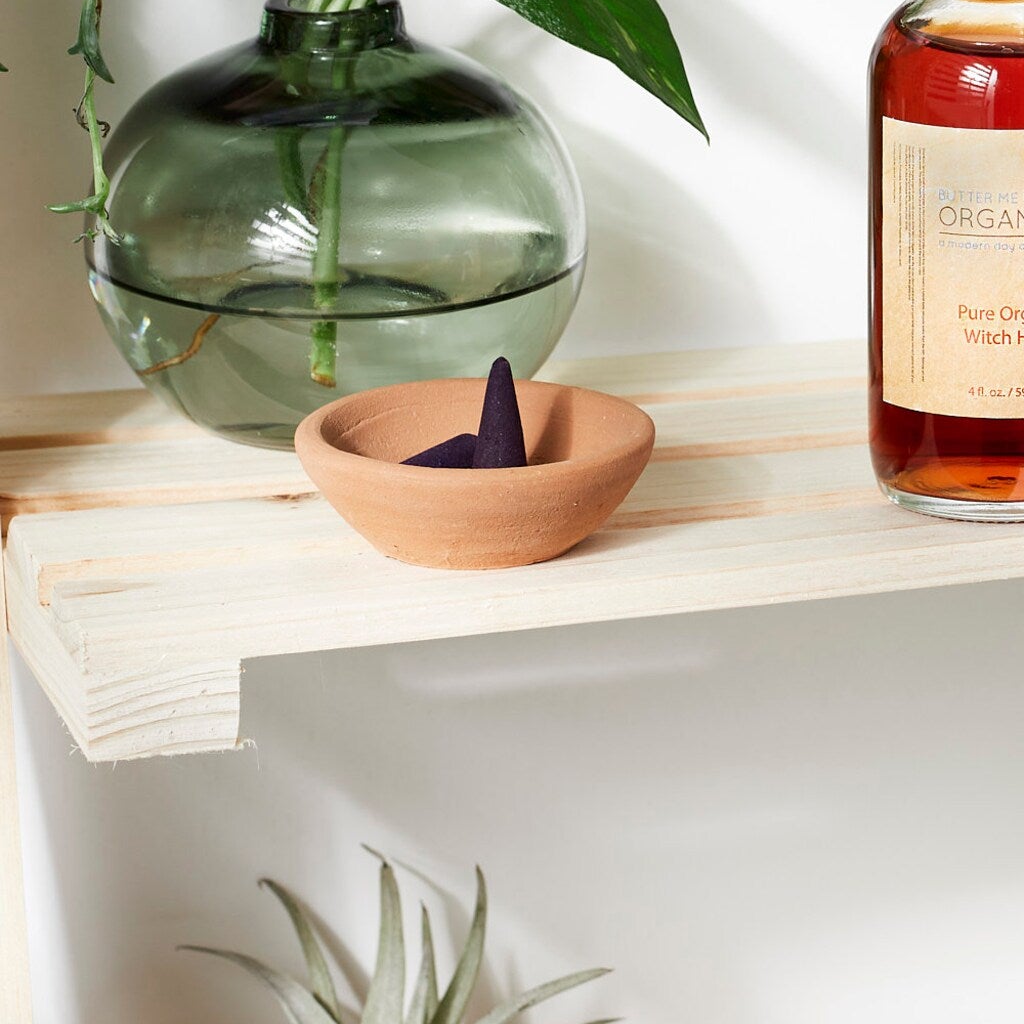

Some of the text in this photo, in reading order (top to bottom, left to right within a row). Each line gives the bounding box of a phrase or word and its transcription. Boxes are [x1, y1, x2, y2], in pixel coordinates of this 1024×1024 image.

[938, 188, 993, 204] BUTTER
[998, 191, 1019, 204] ME
[947, 240, 990, 251] modern
[993, 241, 1016, 253] day
[958, 304, 996, 321] Pure
[963, 328, 1012, 345] Witch
[968, 386, 975, 397] 4
[989, 388, 1006, 398] oz.
